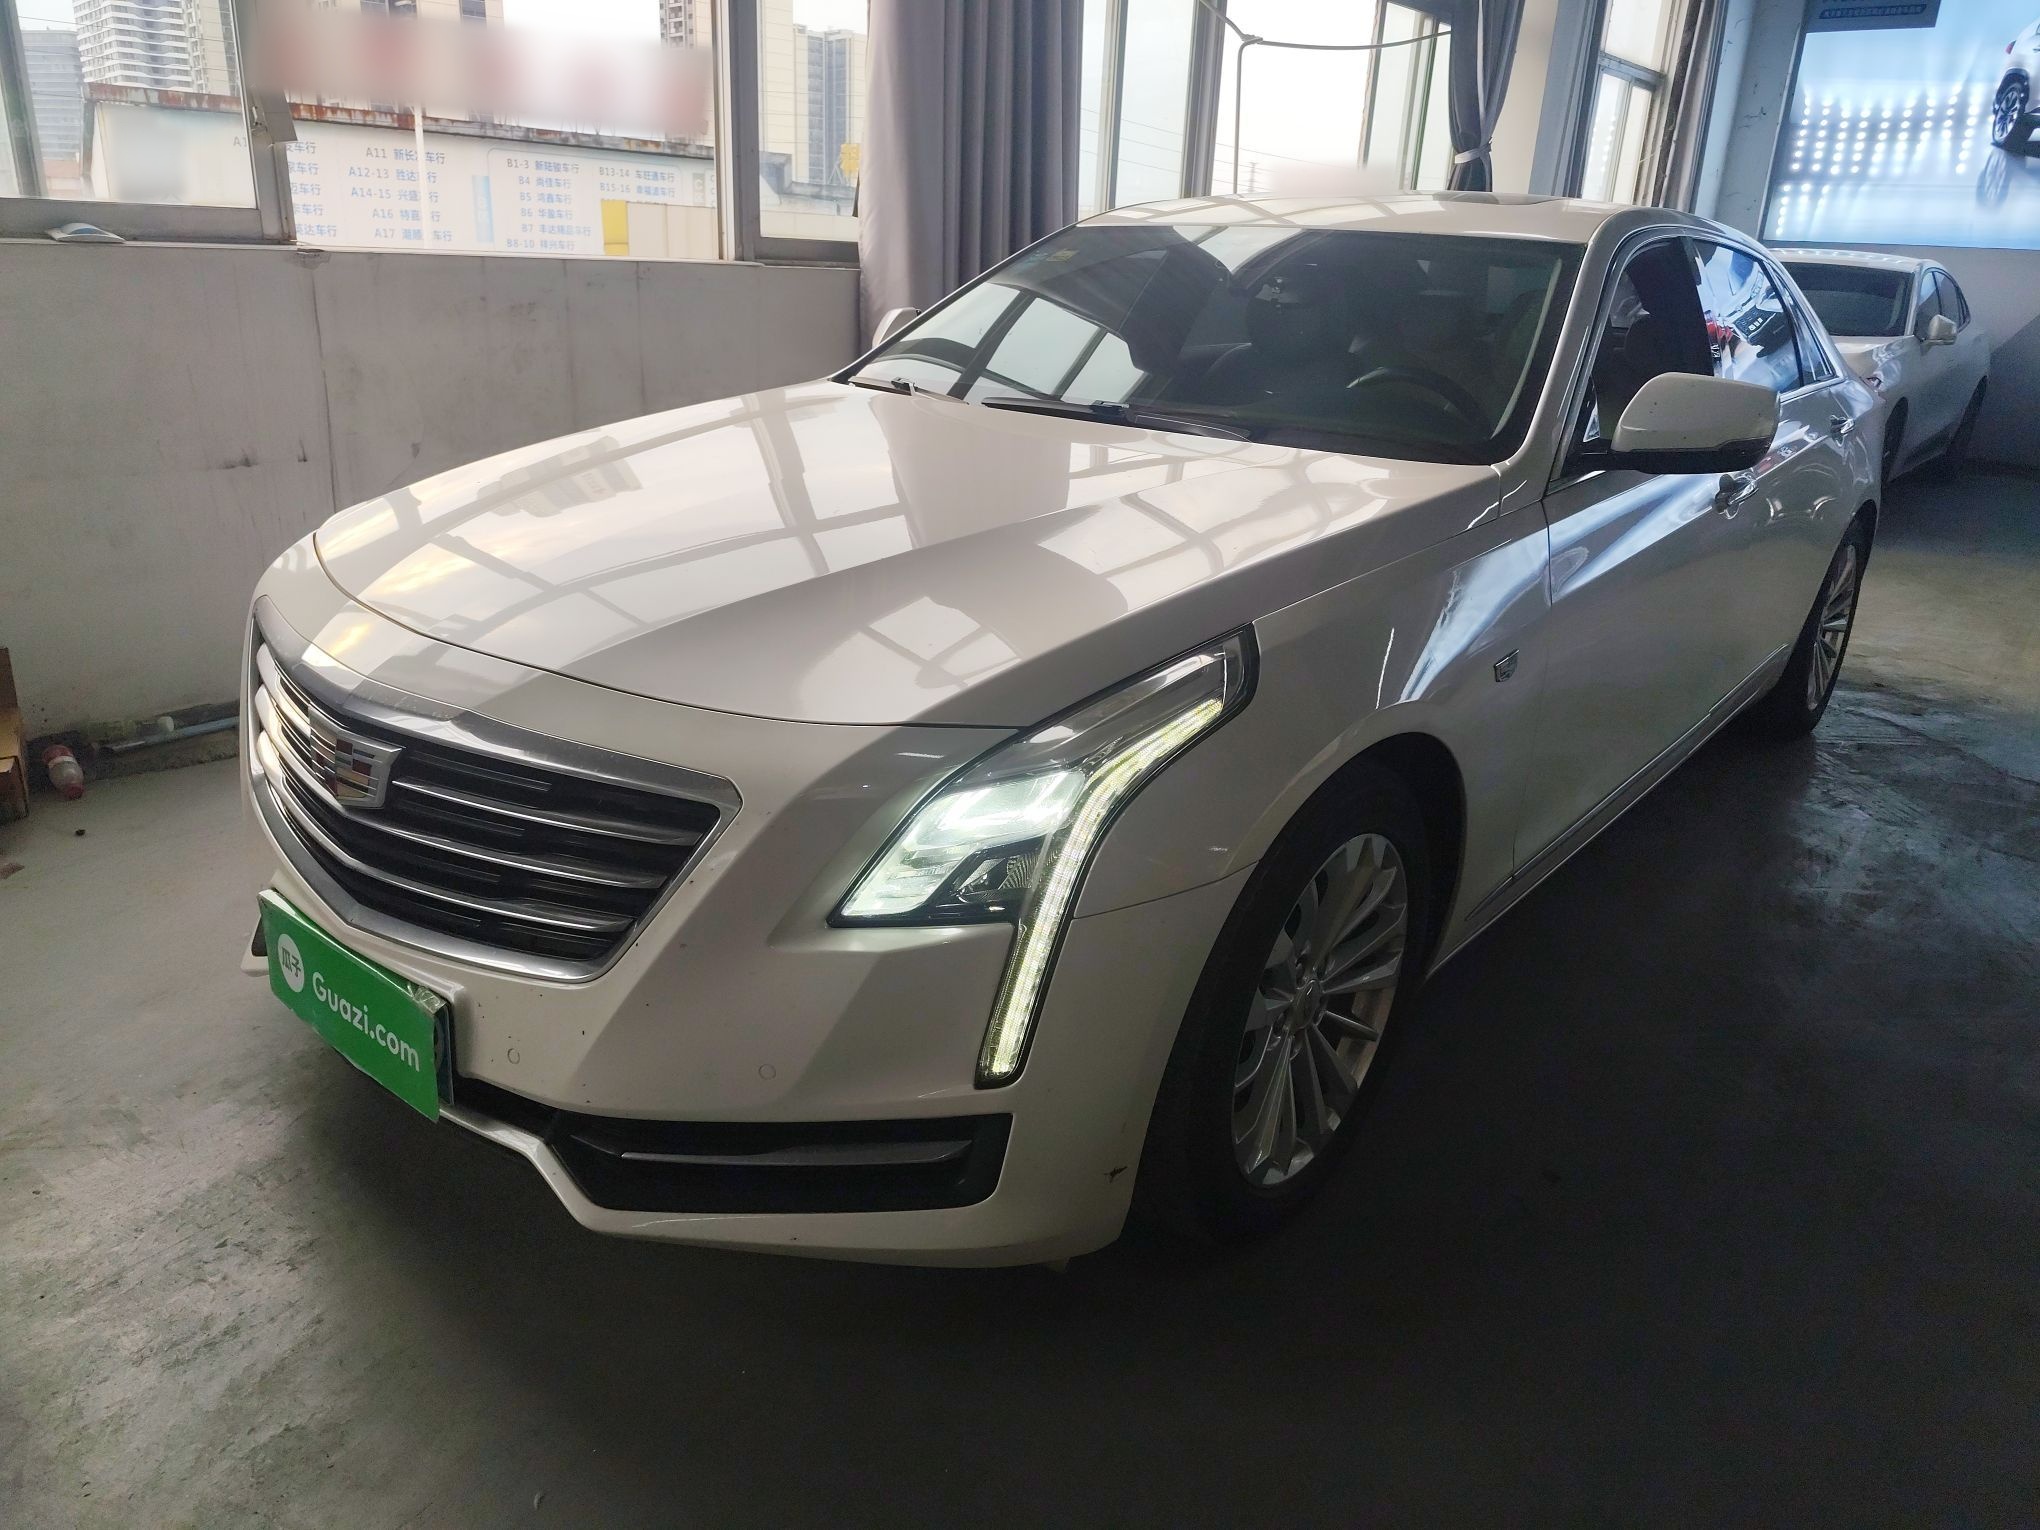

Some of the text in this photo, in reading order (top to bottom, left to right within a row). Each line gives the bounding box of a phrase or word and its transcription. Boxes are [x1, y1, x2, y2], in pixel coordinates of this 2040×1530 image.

[366, 147, 446, 165] A11 新长车行
[506, 158, 529, 169] B1-3
[348, 166, 437, 184] A12-13 胜达行
[599, 166, 630, 177] B13-14
[519, 176, 530, 185] B4
[599, 182, 631, 193] B15-16
[351, 187, 439, 204] A14-15 兴盛行
[520, 192, 532, 201] B5
[372, 208, 394, 219] A16
[520, 207, 533, 217] B6
[374, 228, 396, 239] A17
[521, 223, 533, 233] B7
[281, 946, 302, 978] 瓜子
[312, 971, 420, 1072] Guazi.com
